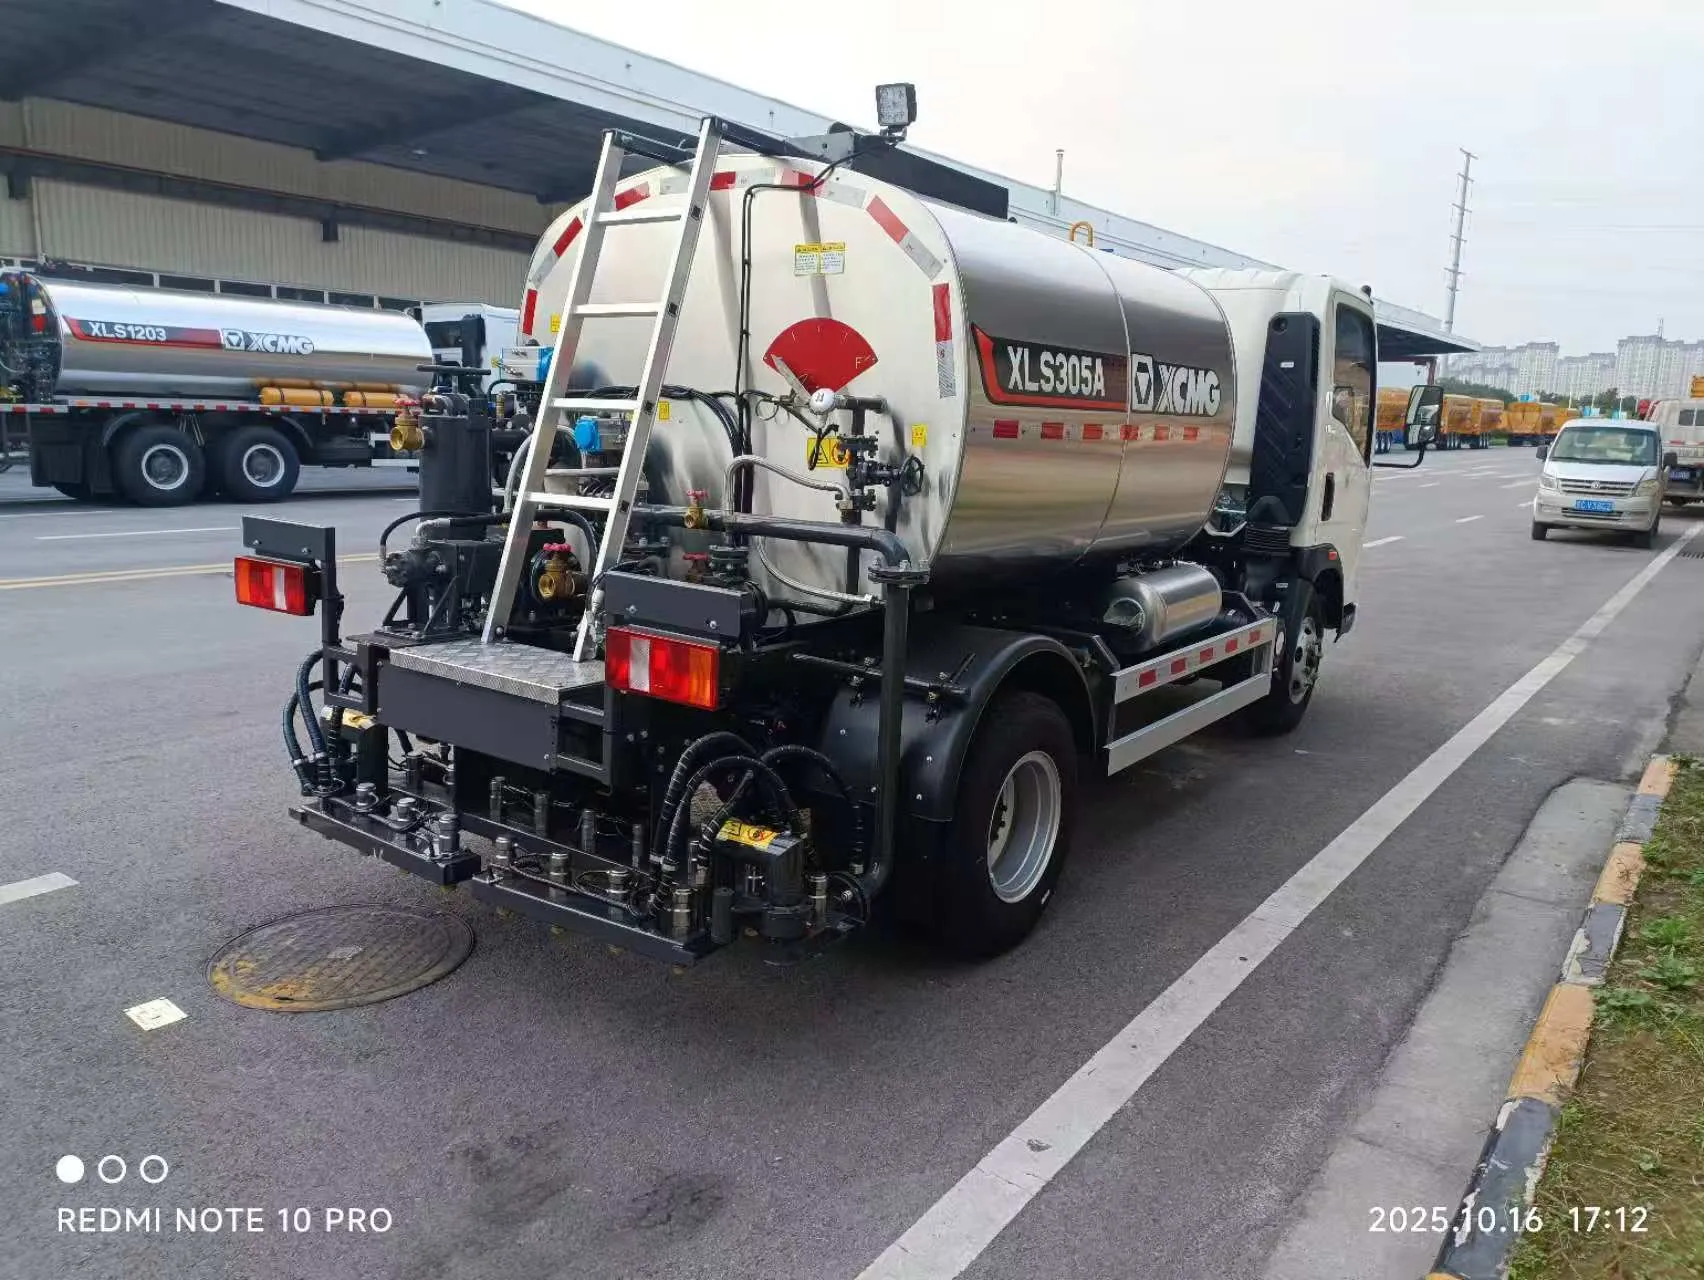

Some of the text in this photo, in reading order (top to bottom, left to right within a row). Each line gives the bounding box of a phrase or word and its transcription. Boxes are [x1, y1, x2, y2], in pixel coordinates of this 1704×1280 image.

[88, 321, 315, 355] XLS1203 XCMG
[1007, 345, 1222, 417] XLS305A XCMG
